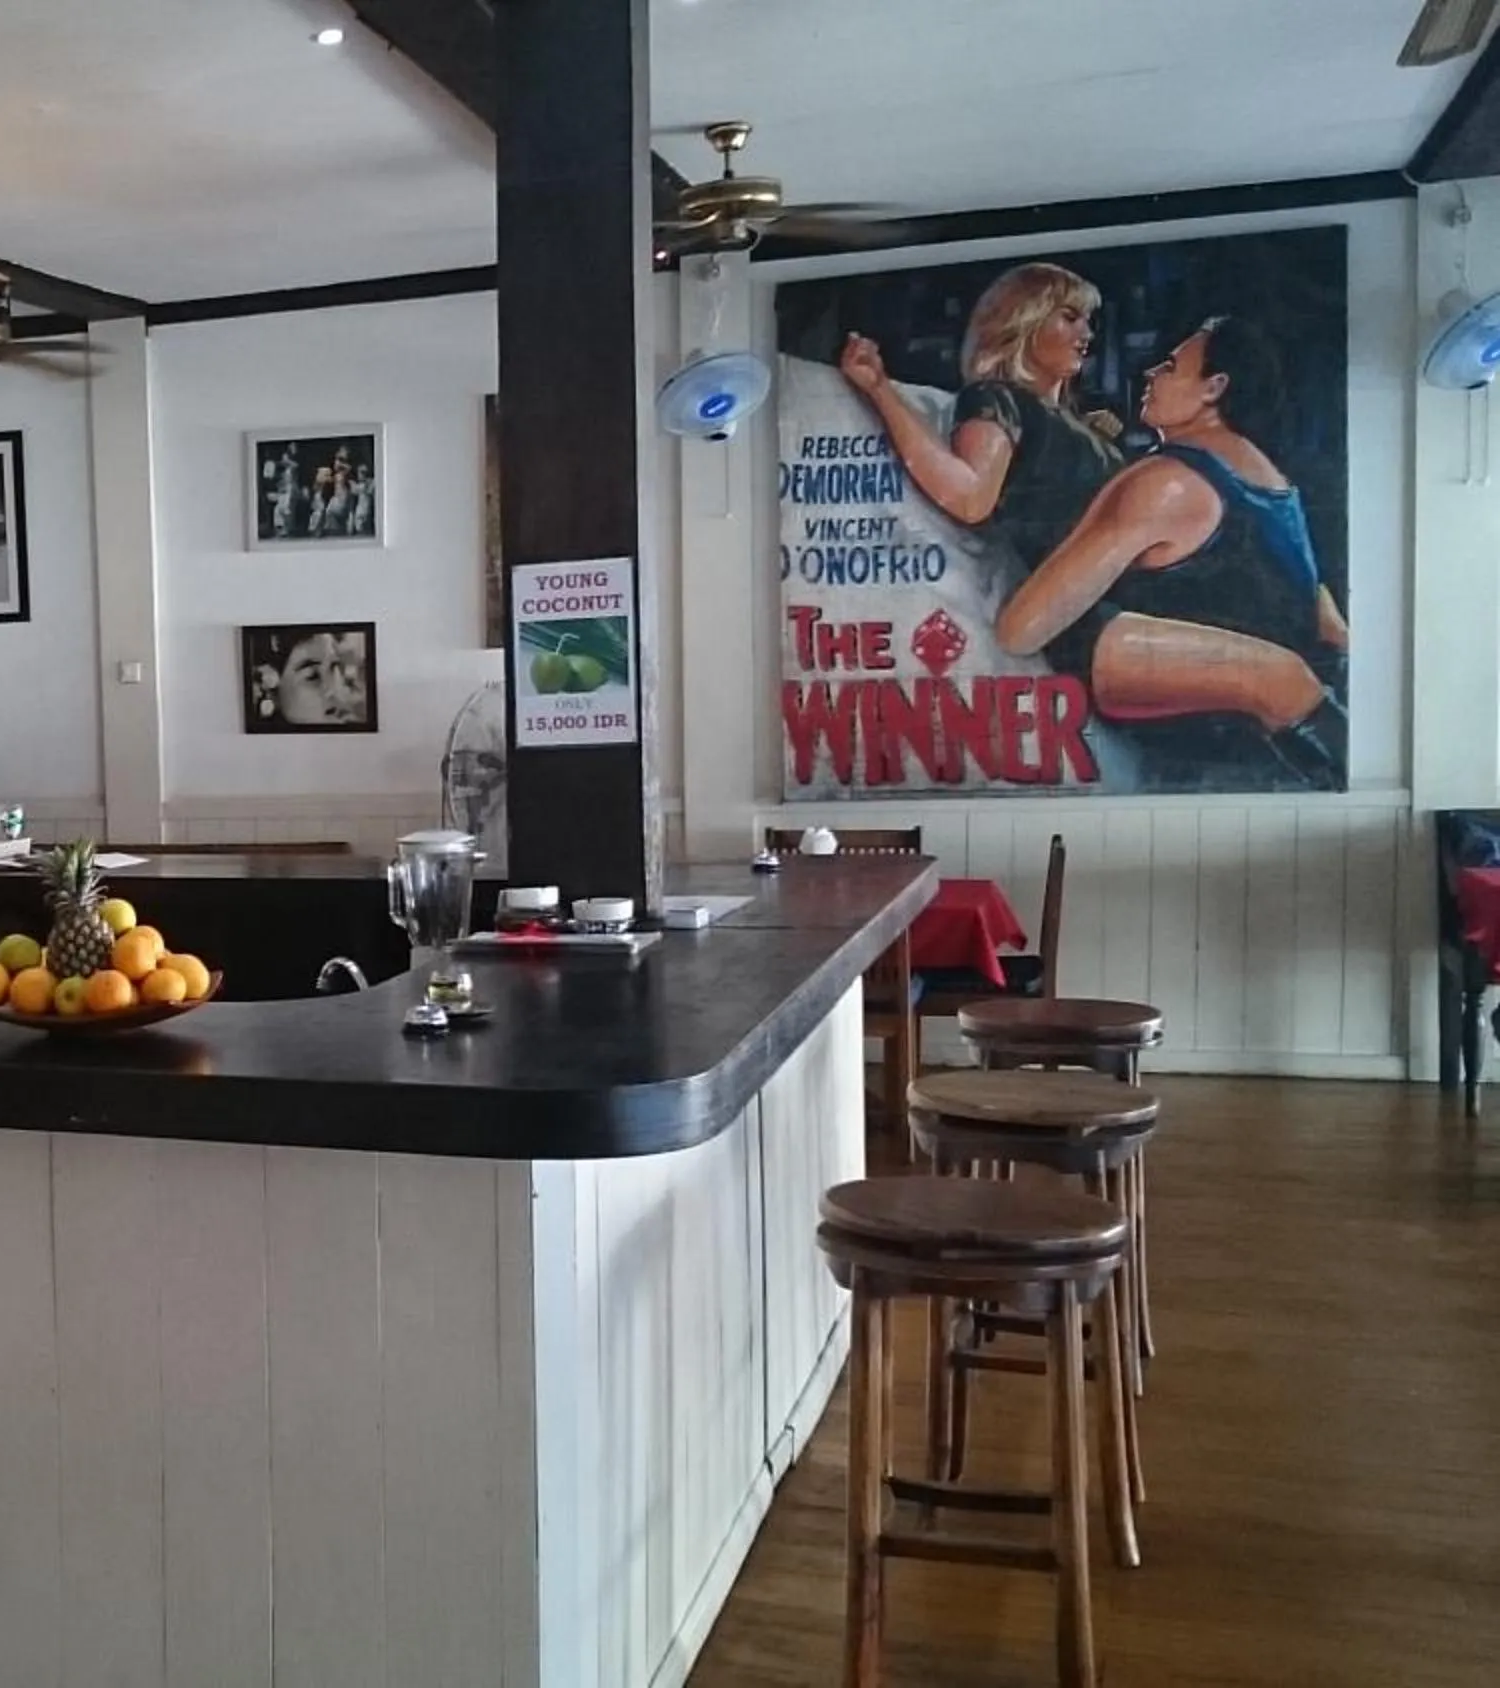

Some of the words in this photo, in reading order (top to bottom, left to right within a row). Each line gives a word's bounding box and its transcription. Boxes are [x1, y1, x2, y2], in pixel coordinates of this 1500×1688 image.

[801, 435, 891, 459] REBECCA
[804, 516, 898, 541] VINCENT
[534, 571, 609, 591] YOUNG
[521, 593, 624, 615] COCONUT
[786, 605, 896, 673] THE
[525, 714, 588, 734] 15,000
[592, 713, 629, 729] IDR
[781, 674, 1100, 787] WINNER
